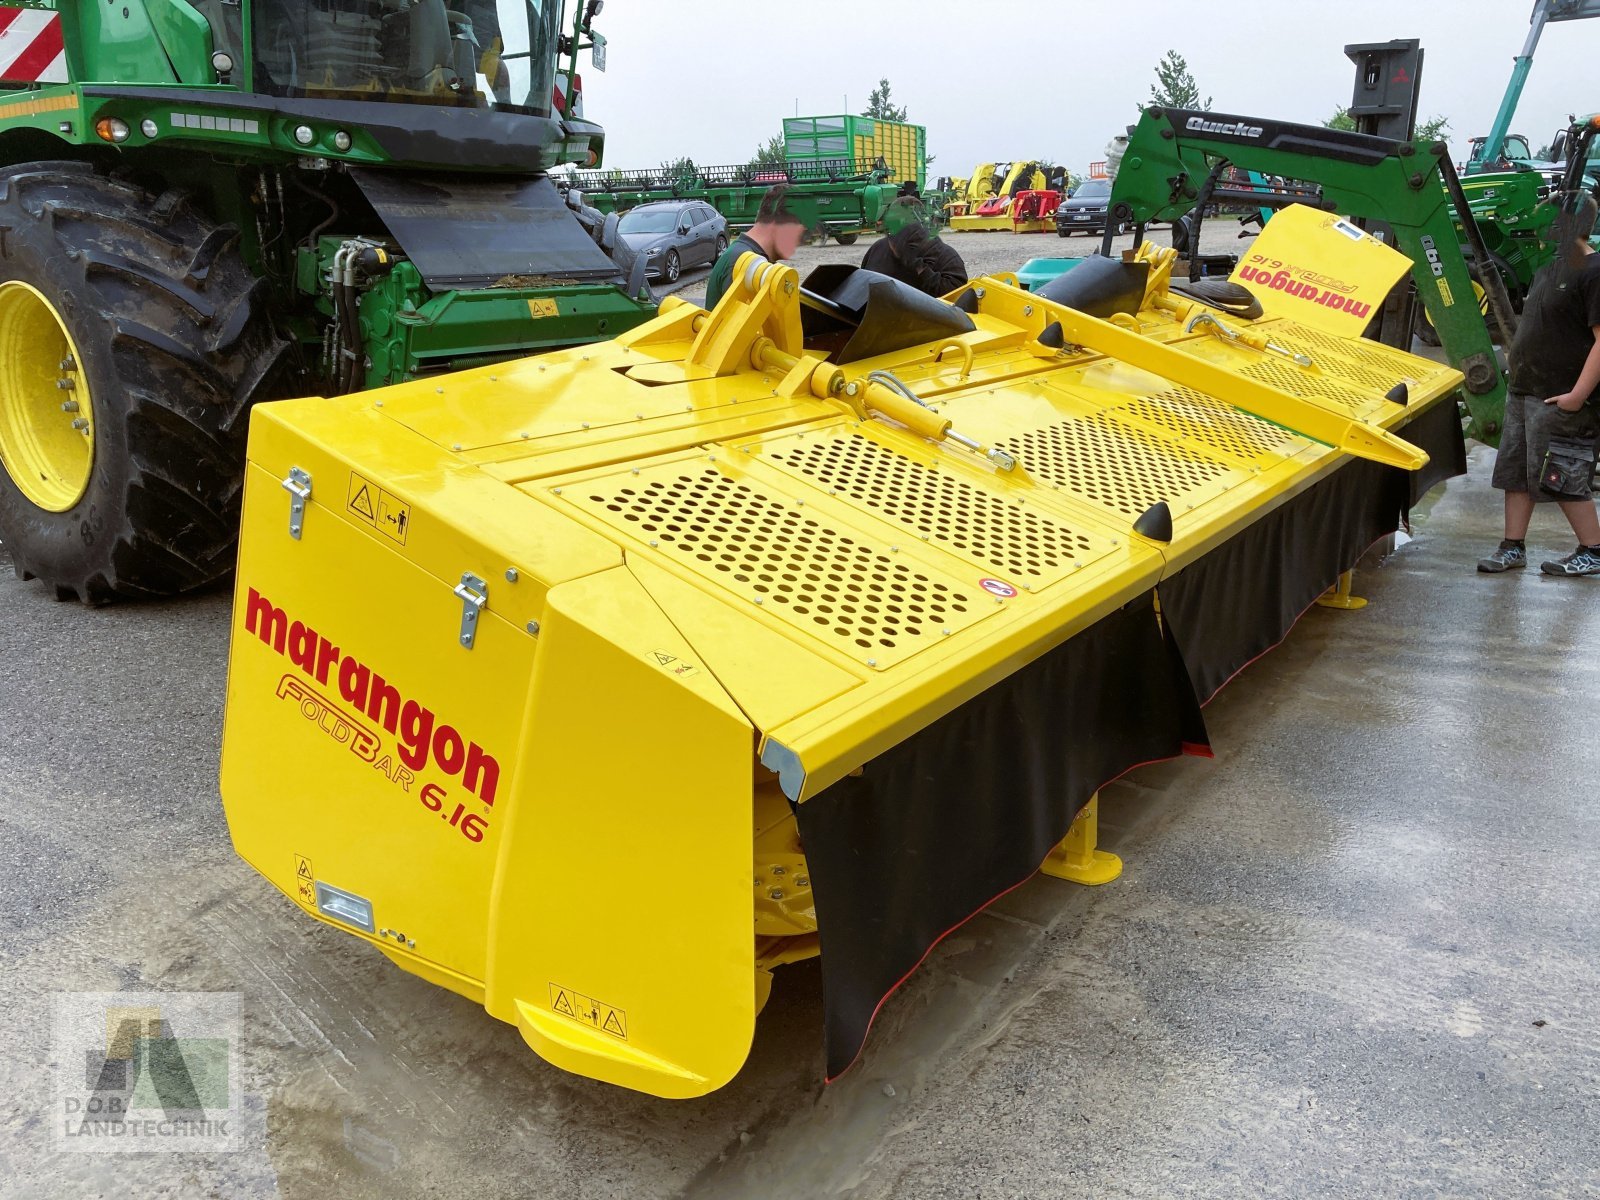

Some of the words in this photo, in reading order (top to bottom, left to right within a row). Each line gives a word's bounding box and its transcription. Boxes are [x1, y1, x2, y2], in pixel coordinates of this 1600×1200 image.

[1186, 116, 1263, 138] Quicke
[1250, 254, 1282, 269] 6.16
[1239, 265, 1371, 318] marangon
[245, 586, 500, 807] marangon
[419, 783, 489, 843] 6.16
